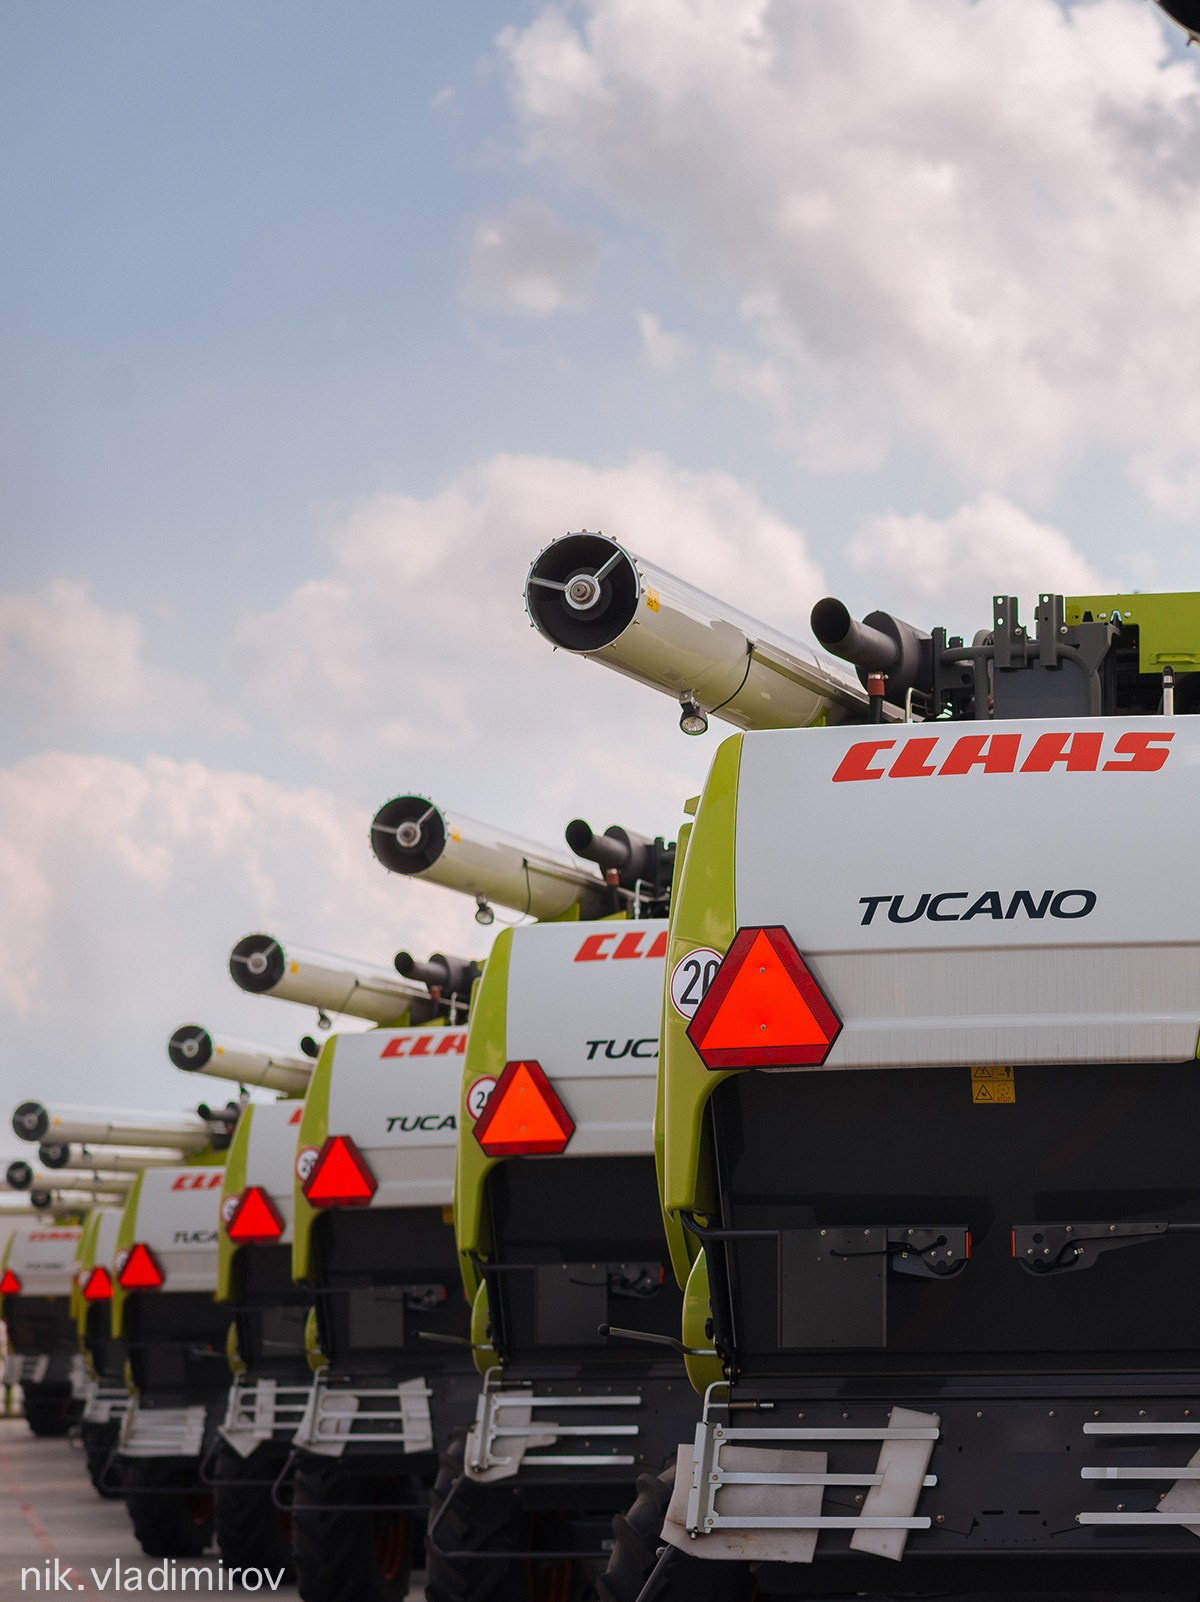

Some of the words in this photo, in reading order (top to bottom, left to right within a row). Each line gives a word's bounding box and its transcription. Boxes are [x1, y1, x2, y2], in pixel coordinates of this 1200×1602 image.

[831, 731, 1176, 783] CLAAS
[858, 889, 1098, 926] TUCANO
[385, 1115, 457, 1133] TUCA
